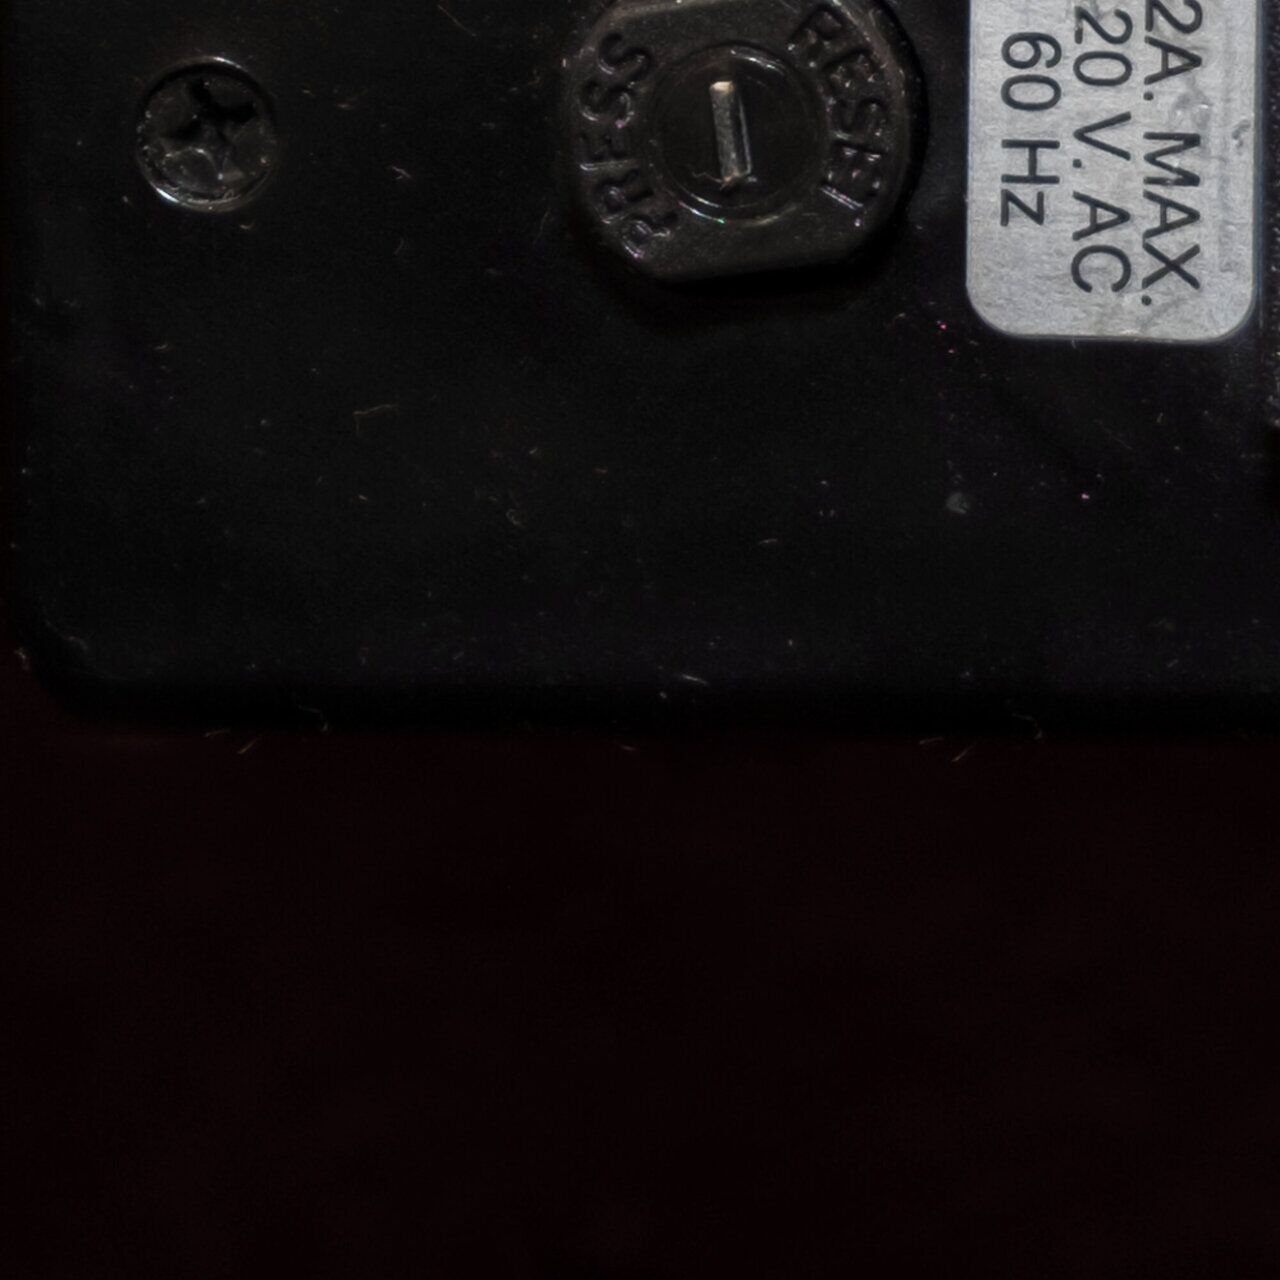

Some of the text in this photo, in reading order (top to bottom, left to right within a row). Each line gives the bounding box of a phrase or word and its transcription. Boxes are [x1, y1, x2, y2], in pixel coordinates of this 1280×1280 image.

[576, 31, 679, 260] PRESS
[786, 3, 890, 222] RESET
[999, 31, 1062, 228] 60 Hz
[1140, 131, 1202, 307] MAX.
